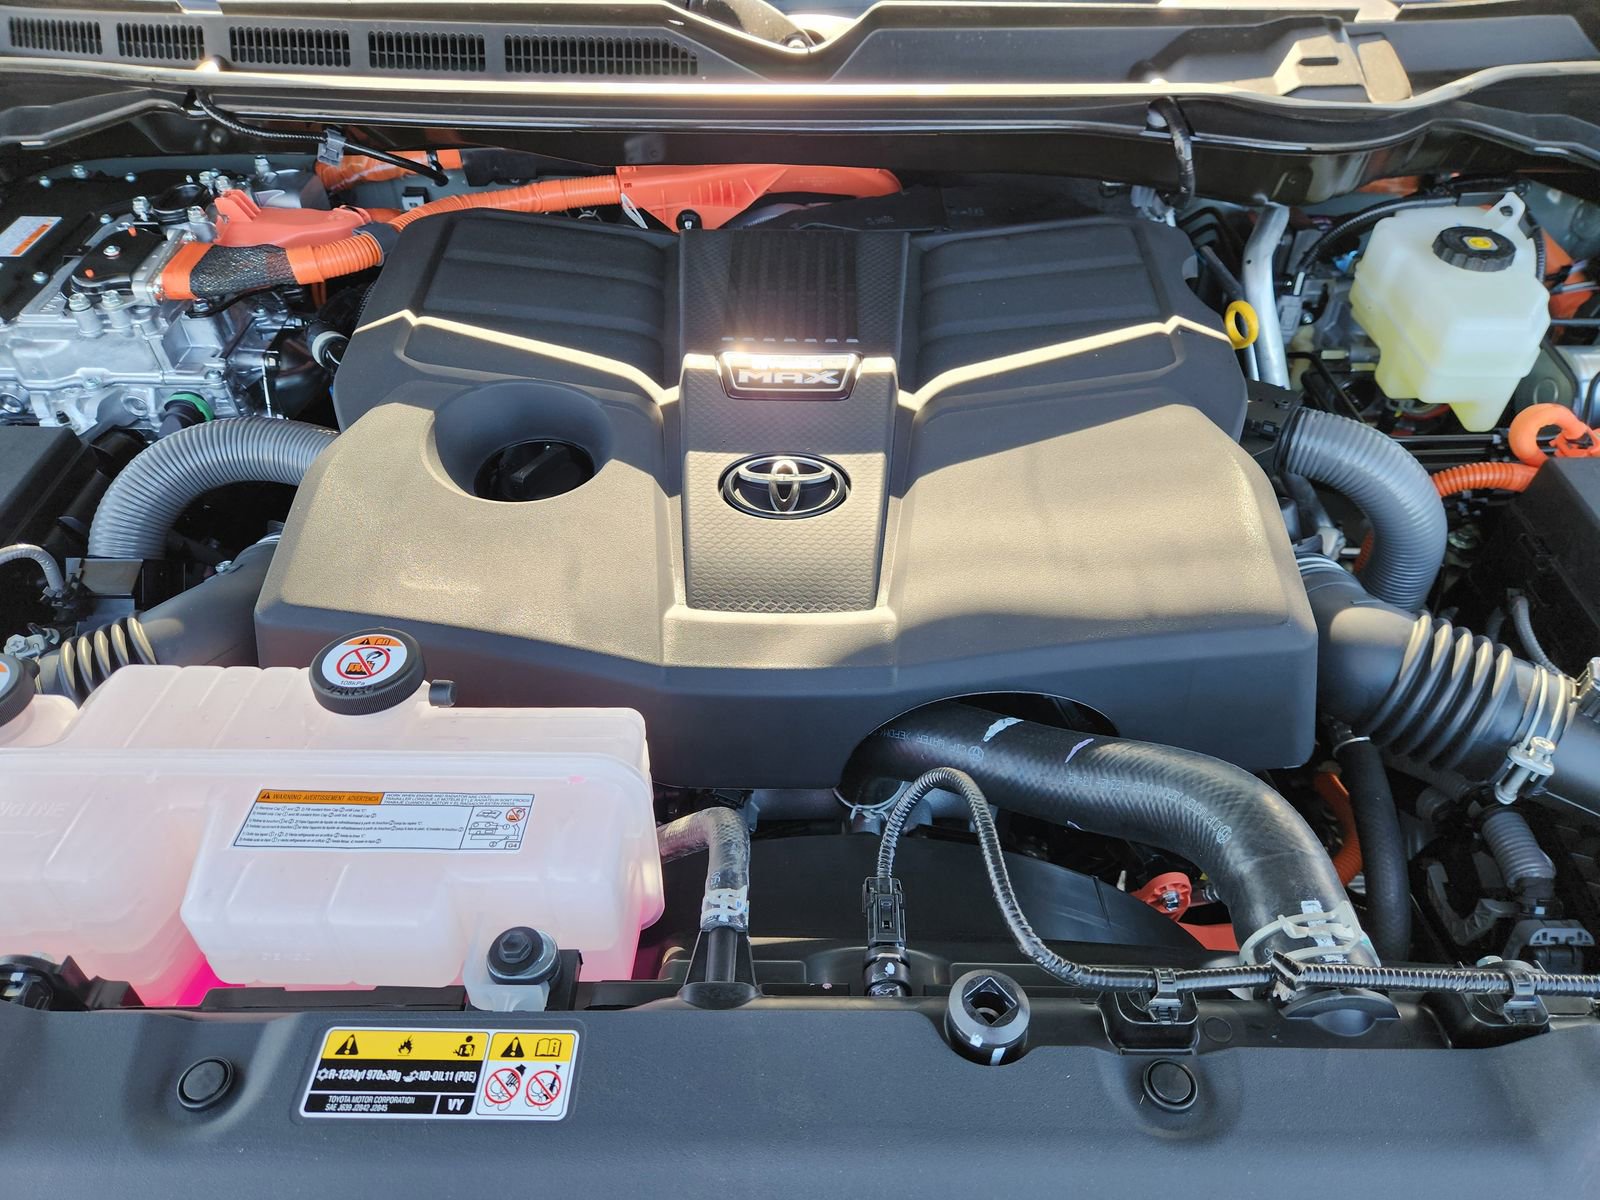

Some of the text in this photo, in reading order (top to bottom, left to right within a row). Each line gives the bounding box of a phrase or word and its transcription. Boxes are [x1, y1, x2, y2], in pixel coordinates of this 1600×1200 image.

[738, 370, 839, 384] MAX
[916, 734, 945, 751] WATER
[1184, 796, 1208, 818] WATER
[328, 1068, 365, 1082] R-1234yf
[366, 1069, 402, 1083] 970±30g
[454, 1071, 477, 1083] (POE)
[328, 1095, 350, 1103] TOYOTA
[447, 1099, 465, 1111] VY
